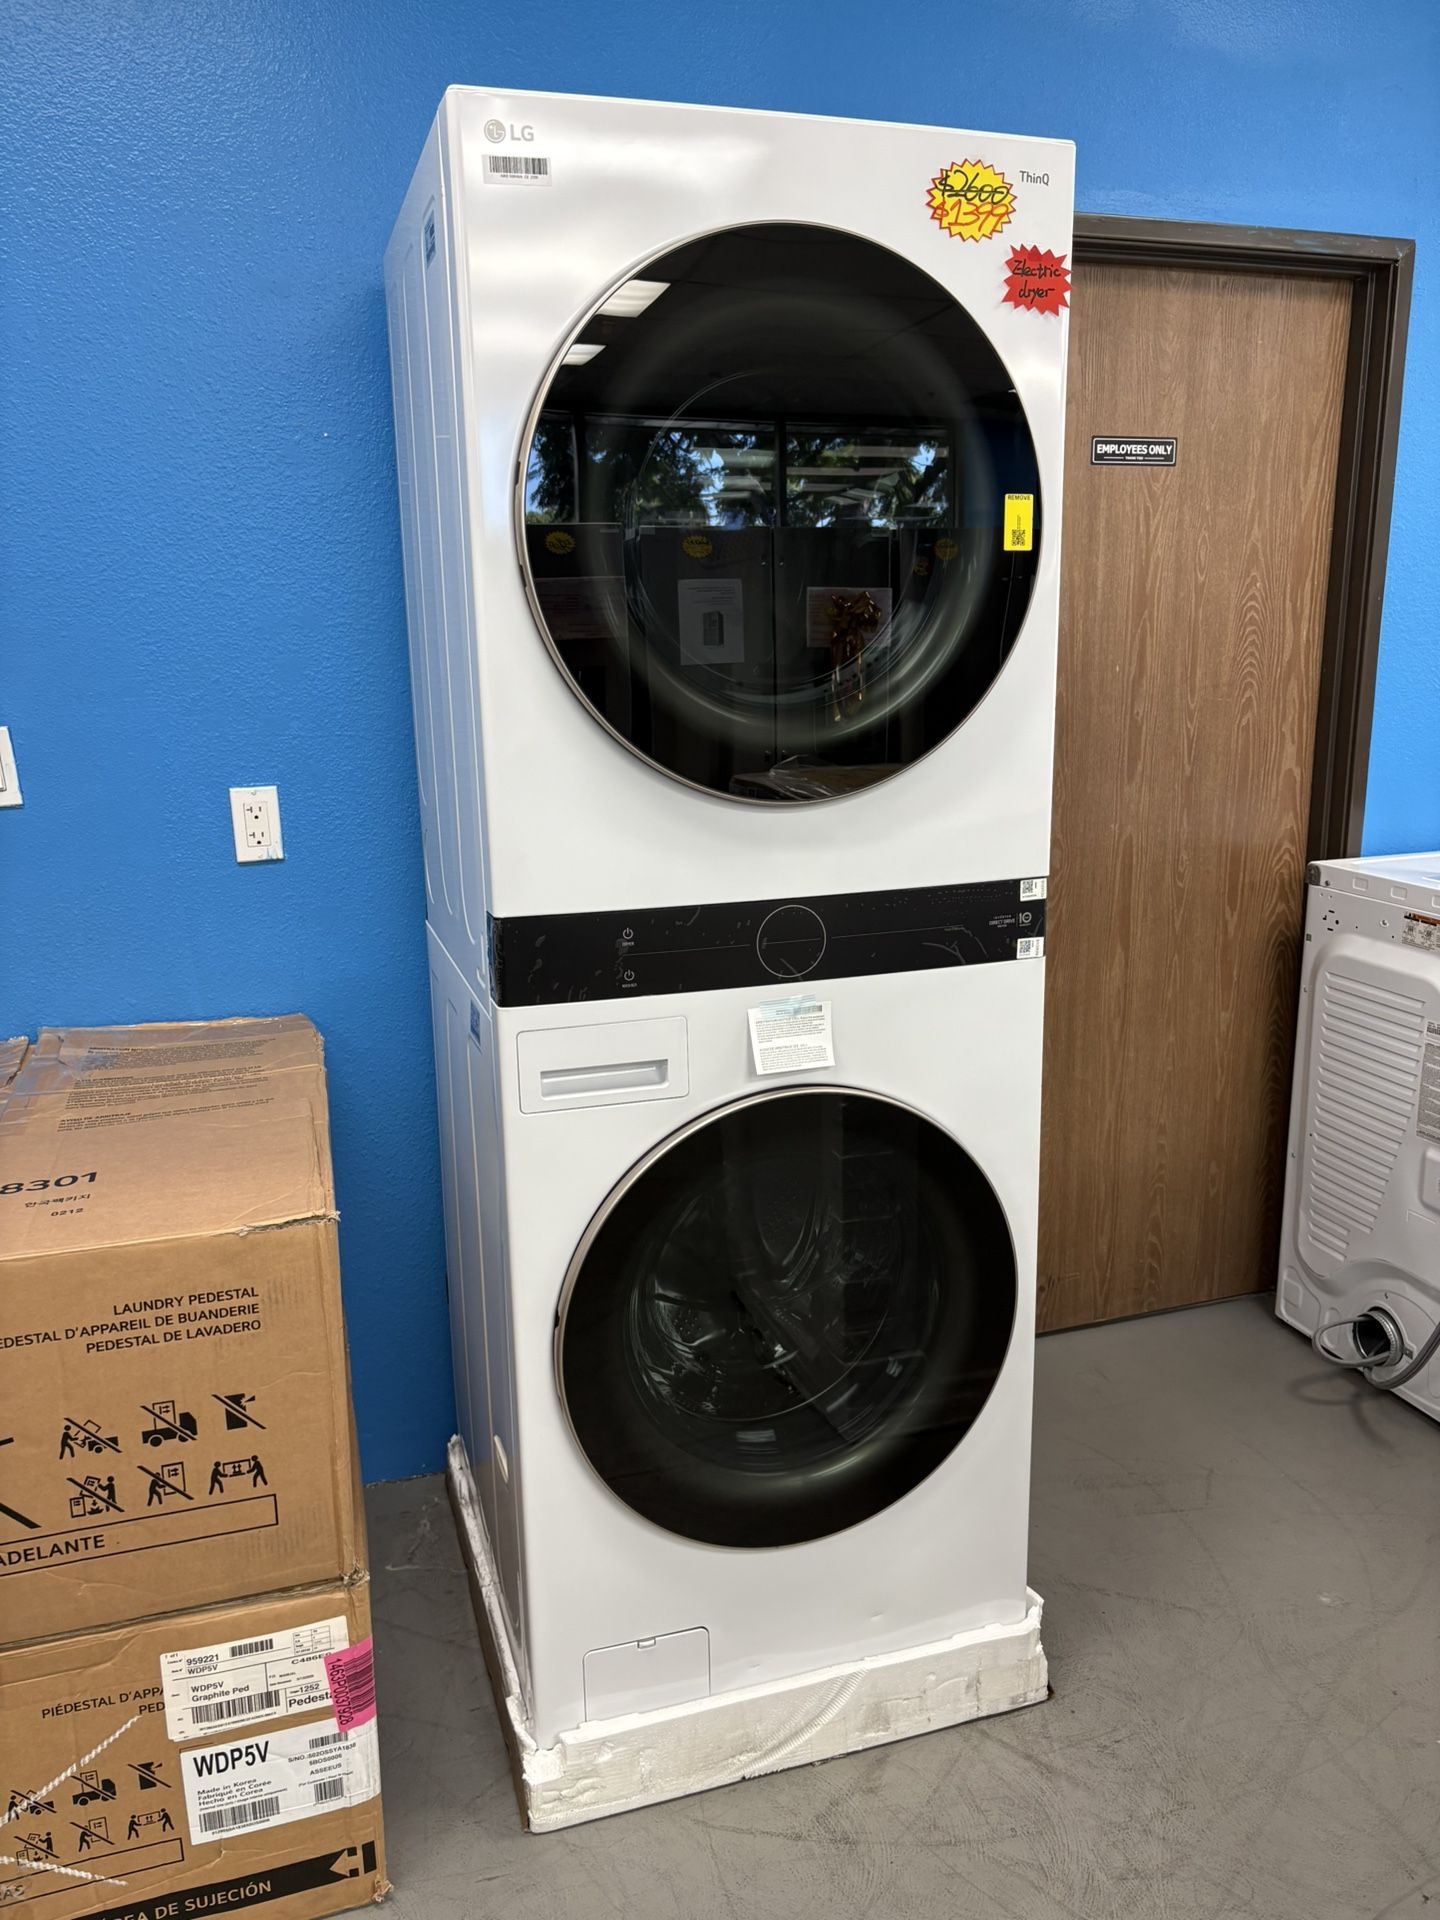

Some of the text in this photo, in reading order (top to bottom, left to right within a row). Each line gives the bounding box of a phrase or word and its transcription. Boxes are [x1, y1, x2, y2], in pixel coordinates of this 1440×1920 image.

[510, 124, 534, 141] LG
[1019, 170, 1050, 186] ThinQ
[933, 199, 1009, 235] $1399
[1018, 280, 1055, 304] dryer
[1096, 444, 1173, 455] EMPLOYEES ONLY
[51, 1208, 83, 1217] 0212
[113, 1287, 259, 1316] LAUNDRY PEDESTAL
[65, 1318, 150, 1340] D'APPAREIL
[155, 1315, 174, 1327] DE
[178, 1303, 260, 1324] BUANDERIE
[86, 1320, 261, 1353] PEDESTAL DE LAVADERO
[186, 1654, 219, 1666] 959221
[192, 1685, 250, 1702] Graphite Ped
[300, 1683, 320, 1693] 1252
[42, 1695, 116, 1719] PIÉDESTAL
[193, 1740, 269, 1778] WDP5V
[197, 1786, 221, 1796] Made
[233, 1779, 257, 1788] Korea
[198, 1789, 233, 1801] Fabriqué
[248, 1780, 272, 1790] Corée
[198, 1796, 225, 1806] Hecho
[239, 1788, 263, 1797] Corea
[155, 1903, 179, 1920] DE
[185, 1880, 272, 1912] SUJECIÓN
